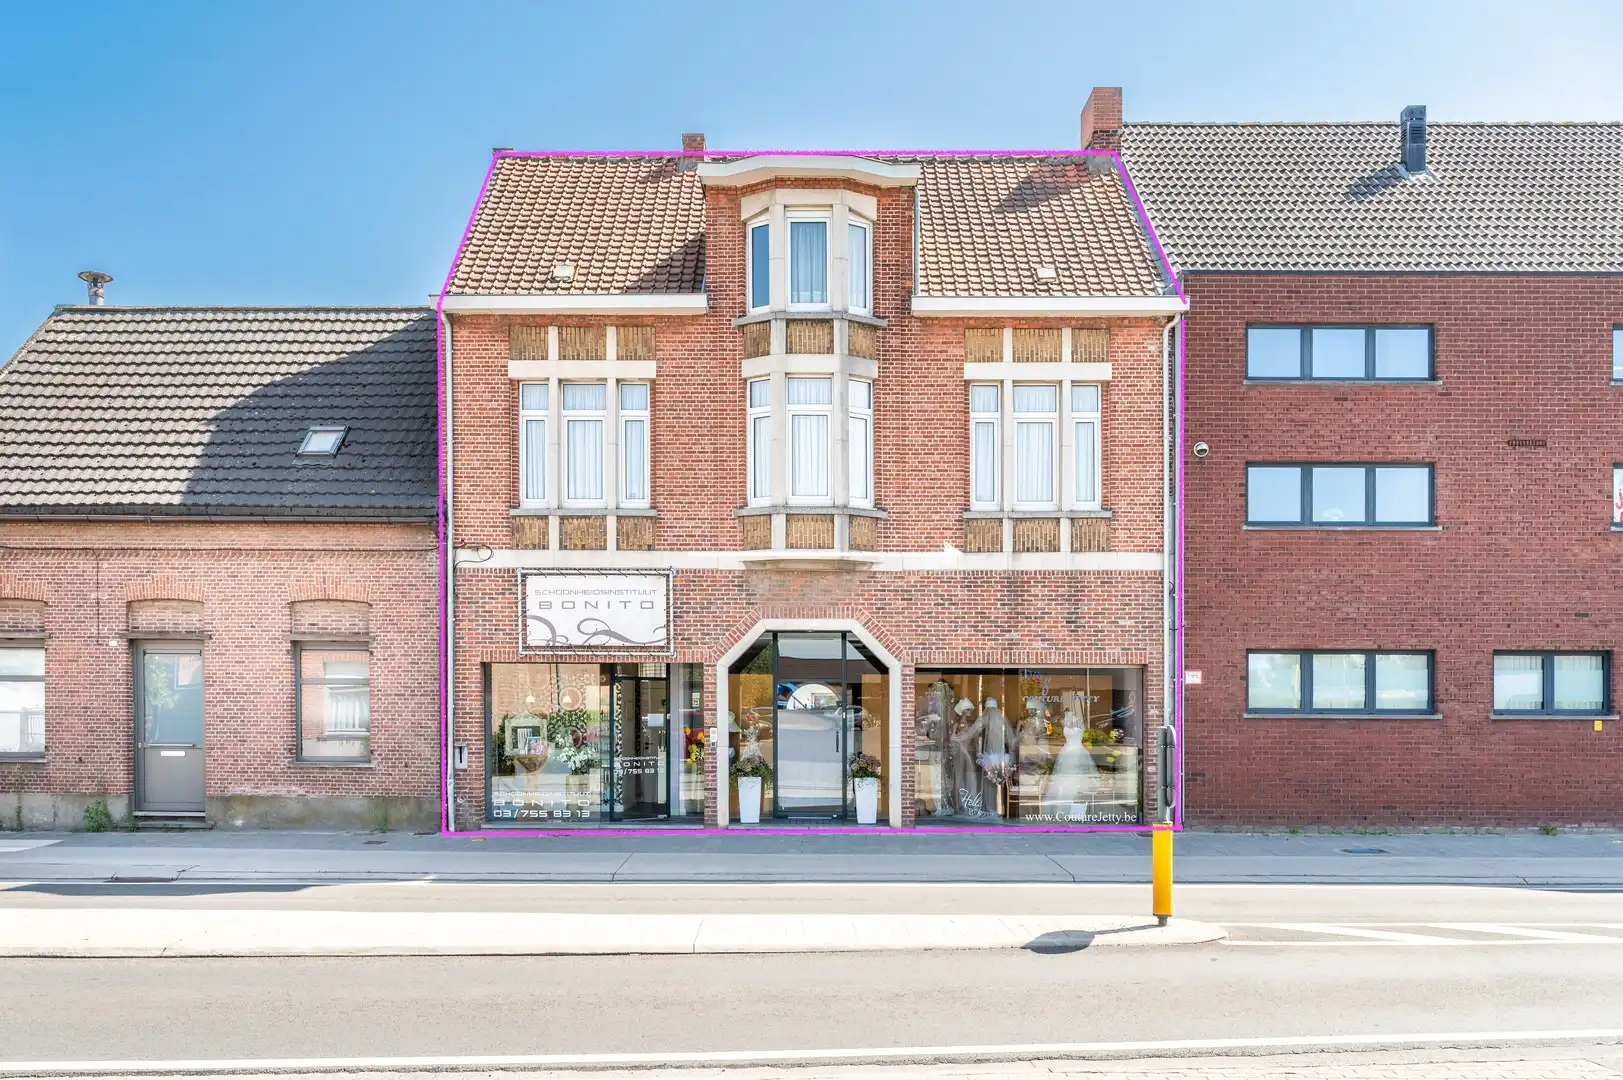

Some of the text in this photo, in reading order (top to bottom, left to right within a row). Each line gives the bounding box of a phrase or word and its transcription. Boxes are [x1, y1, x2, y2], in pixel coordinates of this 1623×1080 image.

[538, 600, 655, 610] BONITO
[493, 799, 590, 807] BONITO
[493, 808, 590, 819] 03/755 83 13
[1025, 811, 1137, 825] www.CoutureJetty.be
